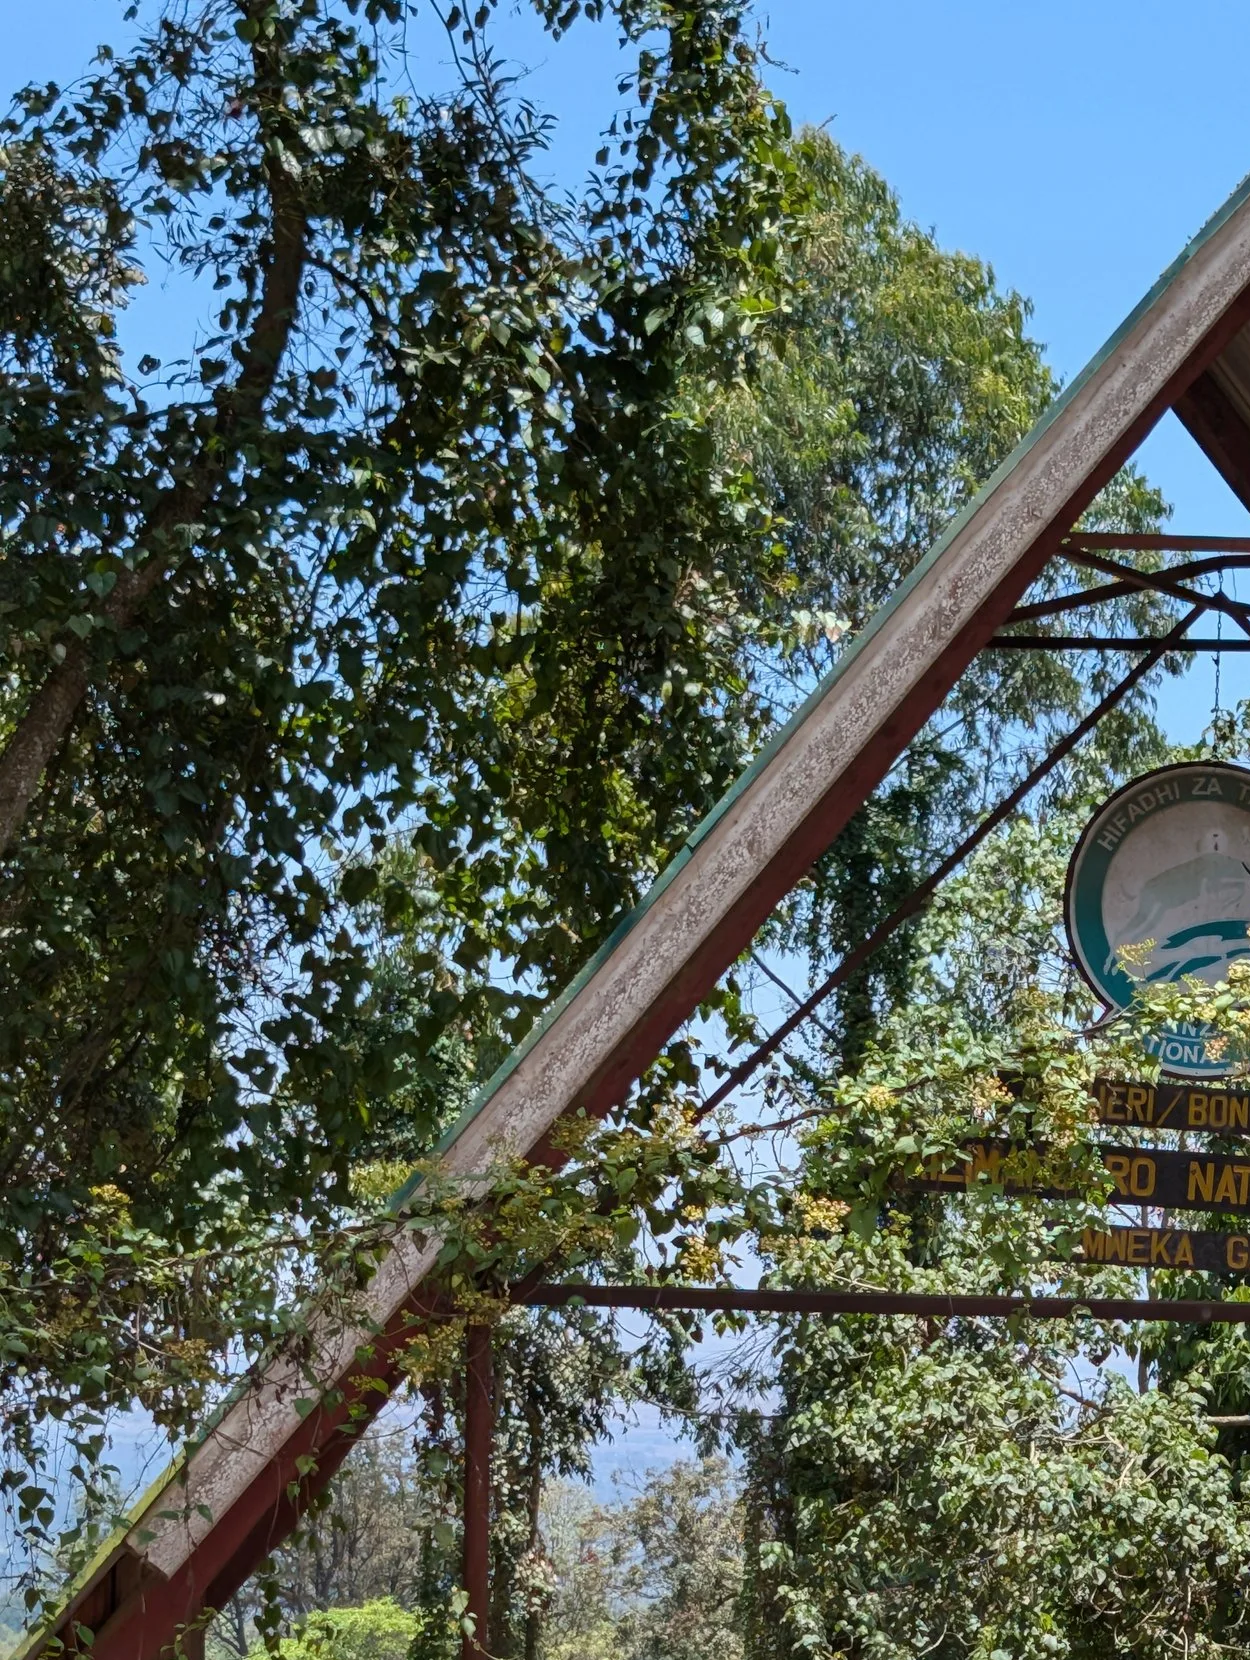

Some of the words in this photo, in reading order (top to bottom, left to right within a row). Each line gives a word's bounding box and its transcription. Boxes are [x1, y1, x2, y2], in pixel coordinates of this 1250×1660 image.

[1097, 782, 1180, 851] HIFADHI
[1191, 777, 1223, 796] ZA
[1081, 1227, 1194, 1267] MWEKA
